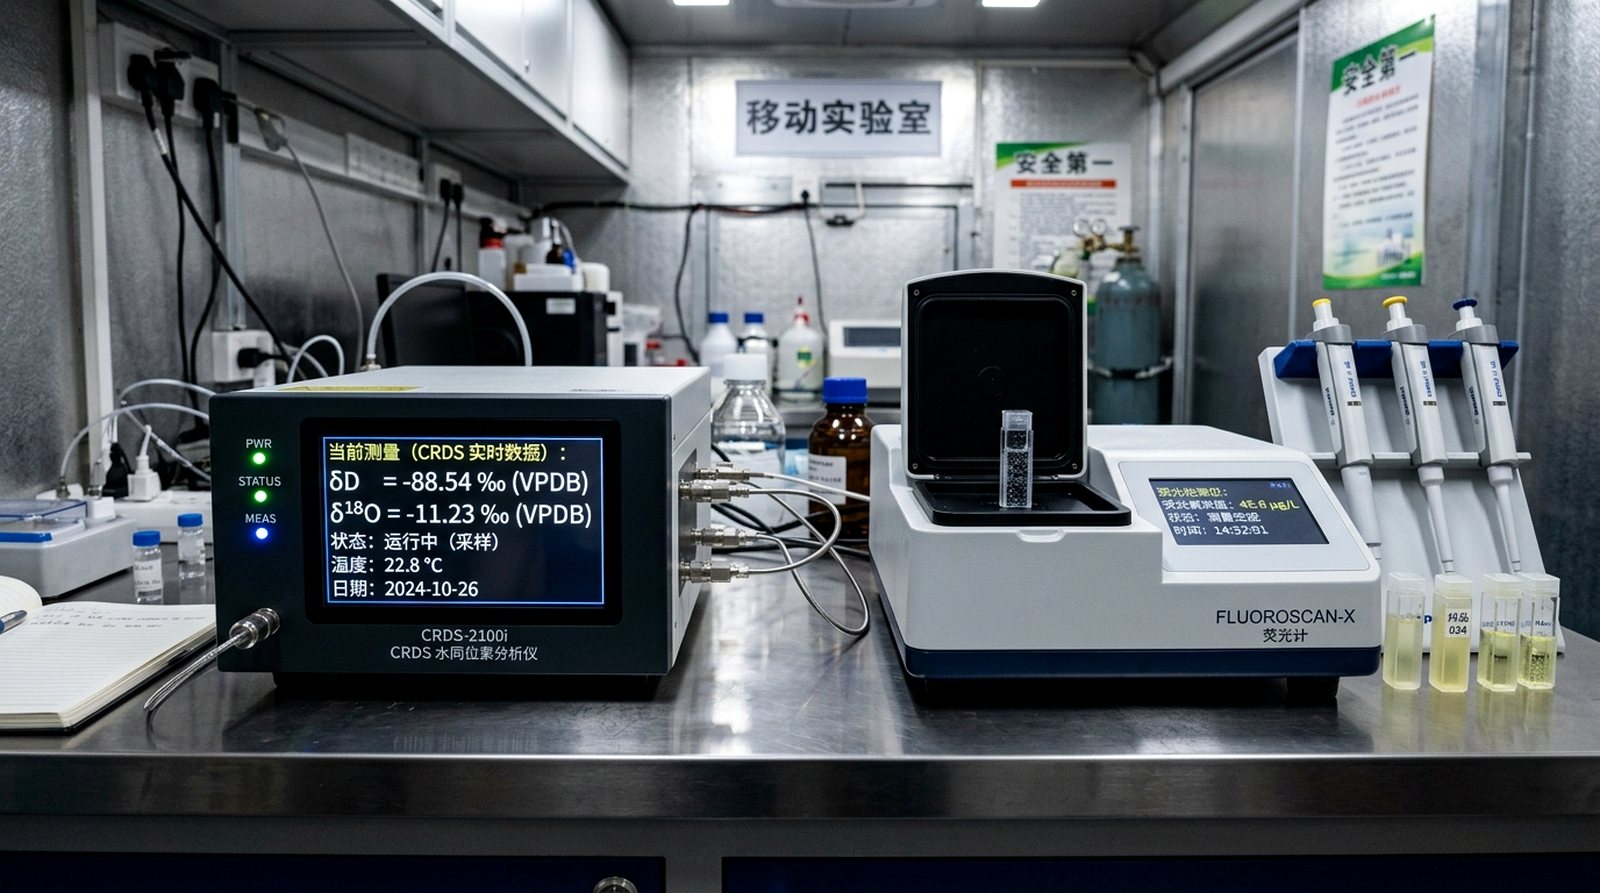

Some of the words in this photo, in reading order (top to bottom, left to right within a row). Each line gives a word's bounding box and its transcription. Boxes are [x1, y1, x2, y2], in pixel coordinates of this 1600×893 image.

[1343, 46, 1416, 97] 安全第一
[748, 99, 931, 135] 移动实验室
[1015, 151, 1113, 174] 安全第一
[245, 438, 272, 449] PWR
[238, 476, 282, 487] STATUS
[329, 469, 360, 492] δD
[402, 471, 472, 492] -88.54
[477, 471, 507, 492] ‰
[512, 470, 588, 497] (VPDB)
[245, 513, 277, 524] MEAS
[406, 503, 475, 524] -11.23
[480, 503, 510, 525] ‰
[515, 502, 592, 529] (VPDB)
[1216, 608, 1356, 625] FLUOROSCAN-X
[421, 628, 508, 643] CRDS-2100i
[1263, 627, 1309, 643] 荧光计
[1448, 625, 1467, 635] 034
[390, 645, 432, 659] CRDS
